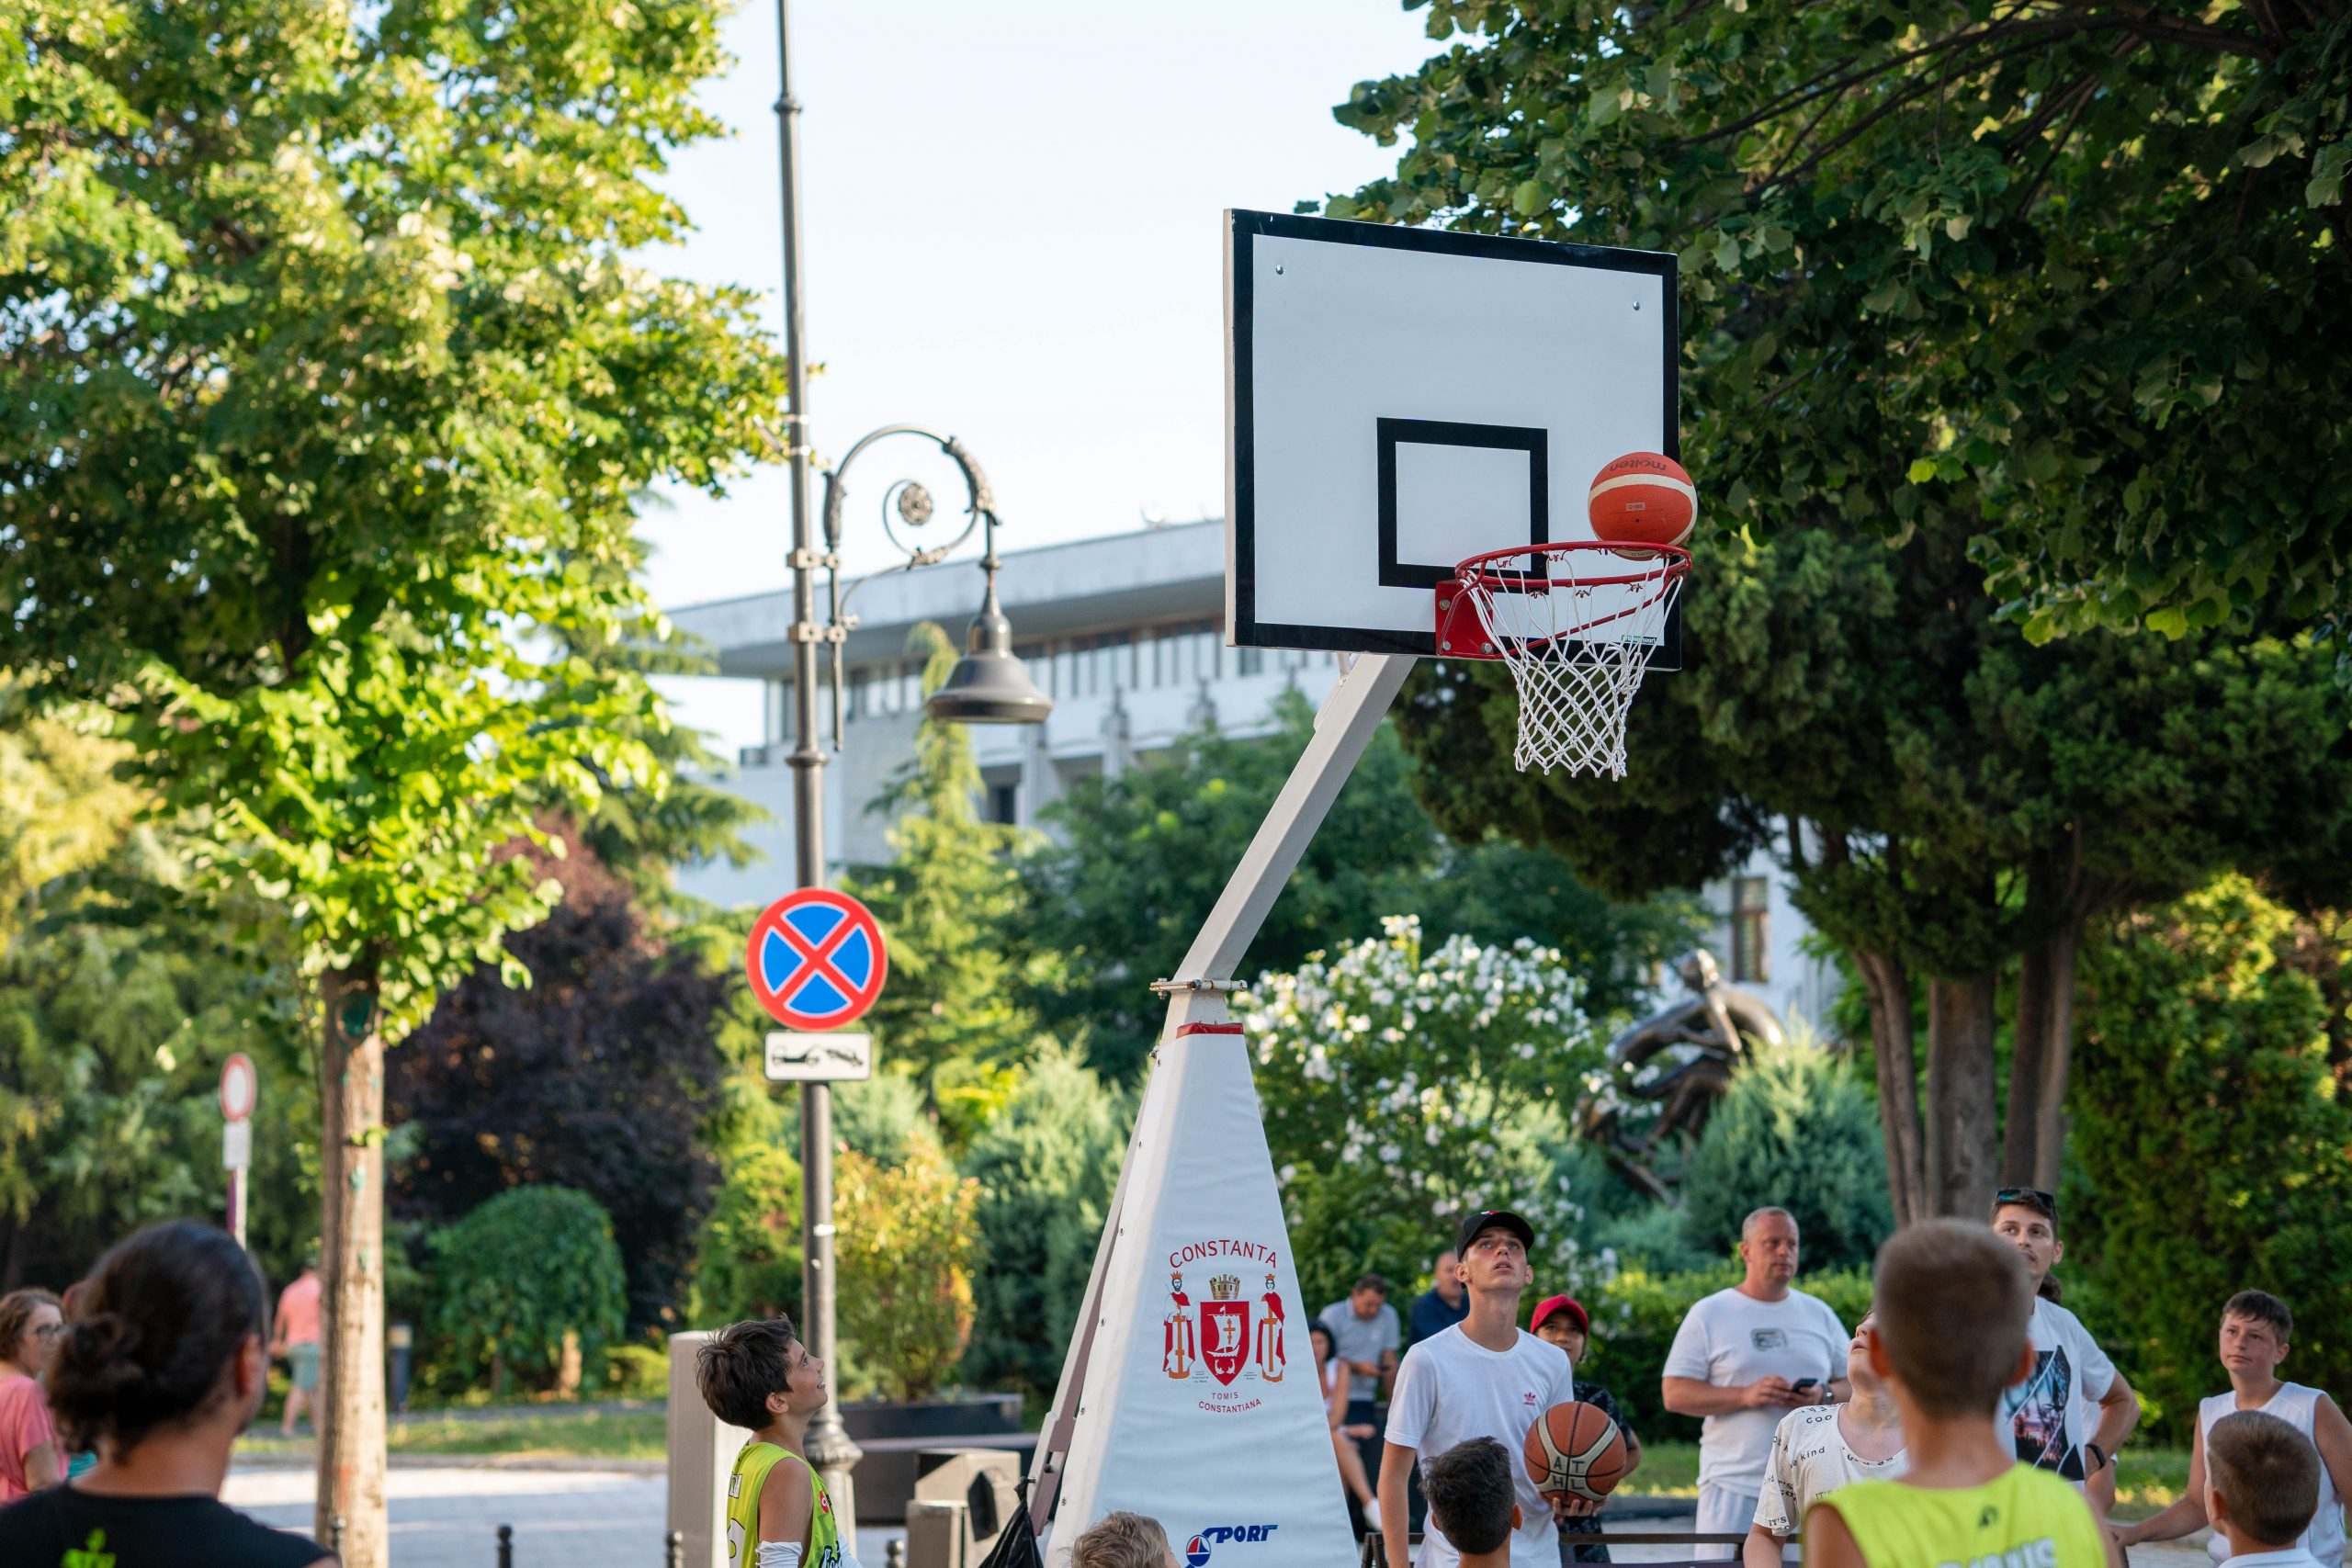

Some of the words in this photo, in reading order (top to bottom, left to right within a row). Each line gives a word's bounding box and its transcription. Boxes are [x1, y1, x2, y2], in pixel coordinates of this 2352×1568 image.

[1610, 459, 1668, 471] molten
[1170, 1240, 1276, 1269] CONSTANTA
[1211, 1392, 1239, 1401] TOMIS
[1198, 1398, 1261, 1414] CONSTANTIANA
[1800, 1446, 1826, 1461] kind
[1769, 1516, 1787, 1527] IT'S
